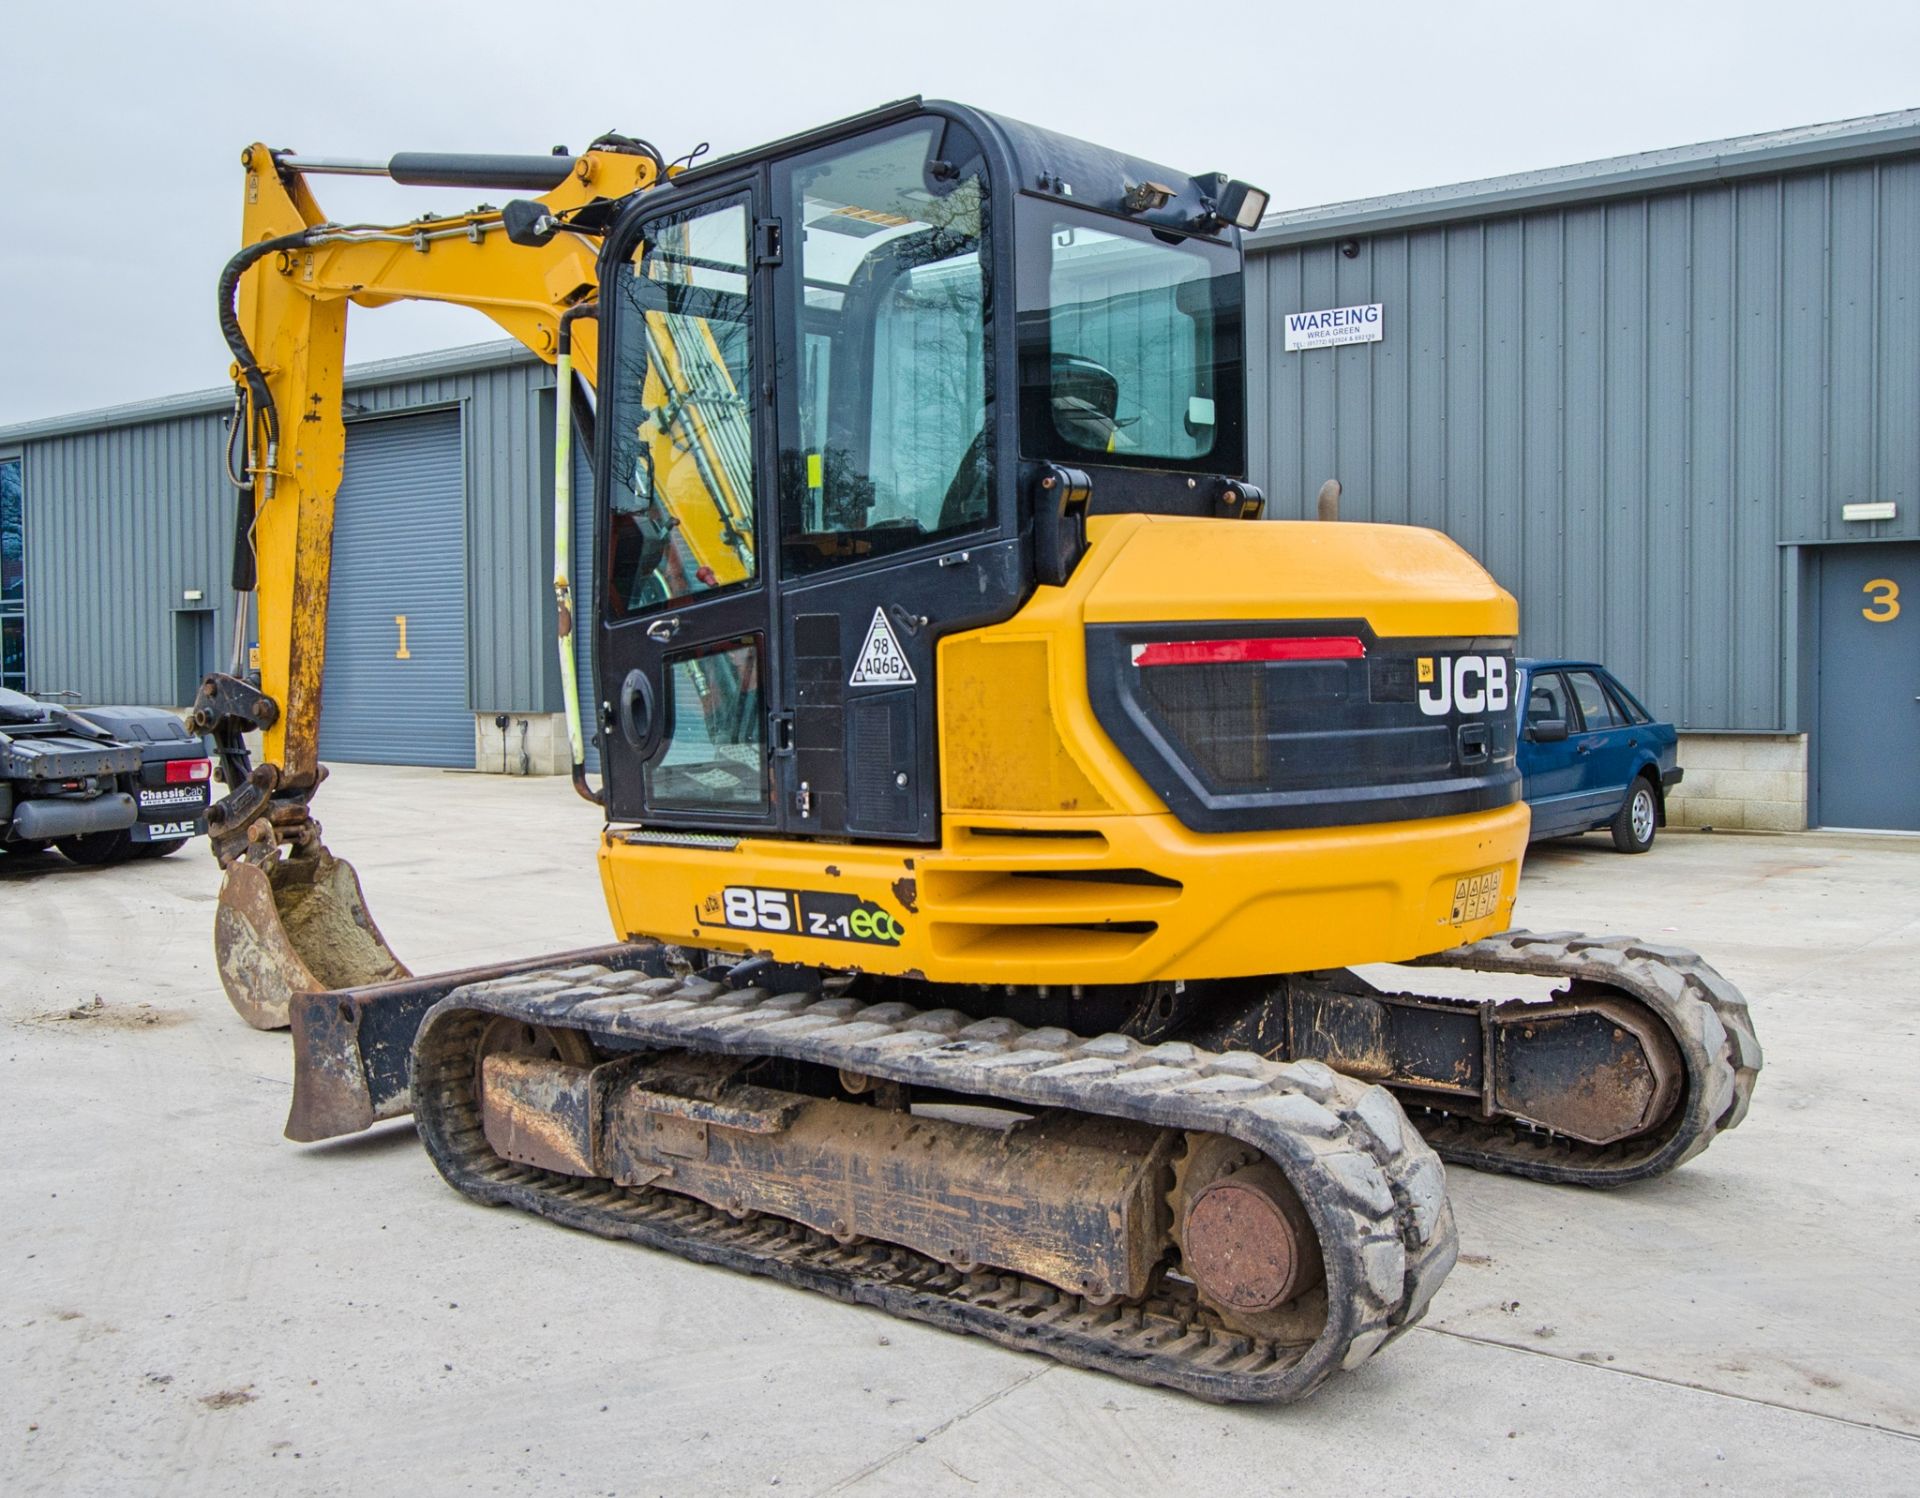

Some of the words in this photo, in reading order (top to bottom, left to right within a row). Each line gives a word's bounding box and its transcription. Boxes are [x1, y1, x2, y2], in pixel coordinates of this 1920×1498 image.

[1290, 307, 1378, 332] WAREING
[1307, 330, 1331, 339] WREA
[1333, 326, 1360, 336] GREEN
[1862, 578, 1900, 622] 3
[395, 614, 410, 659] 1
[873, 638, 888, 656] 98
[865, 656, 899, 675] AQ6G
[1418, 655, 1508, 716] JCB
[148, 821, 194, 835] DAF
[723, 888, 791, 931] 85
[808, 912, 850, 938] Z-1
